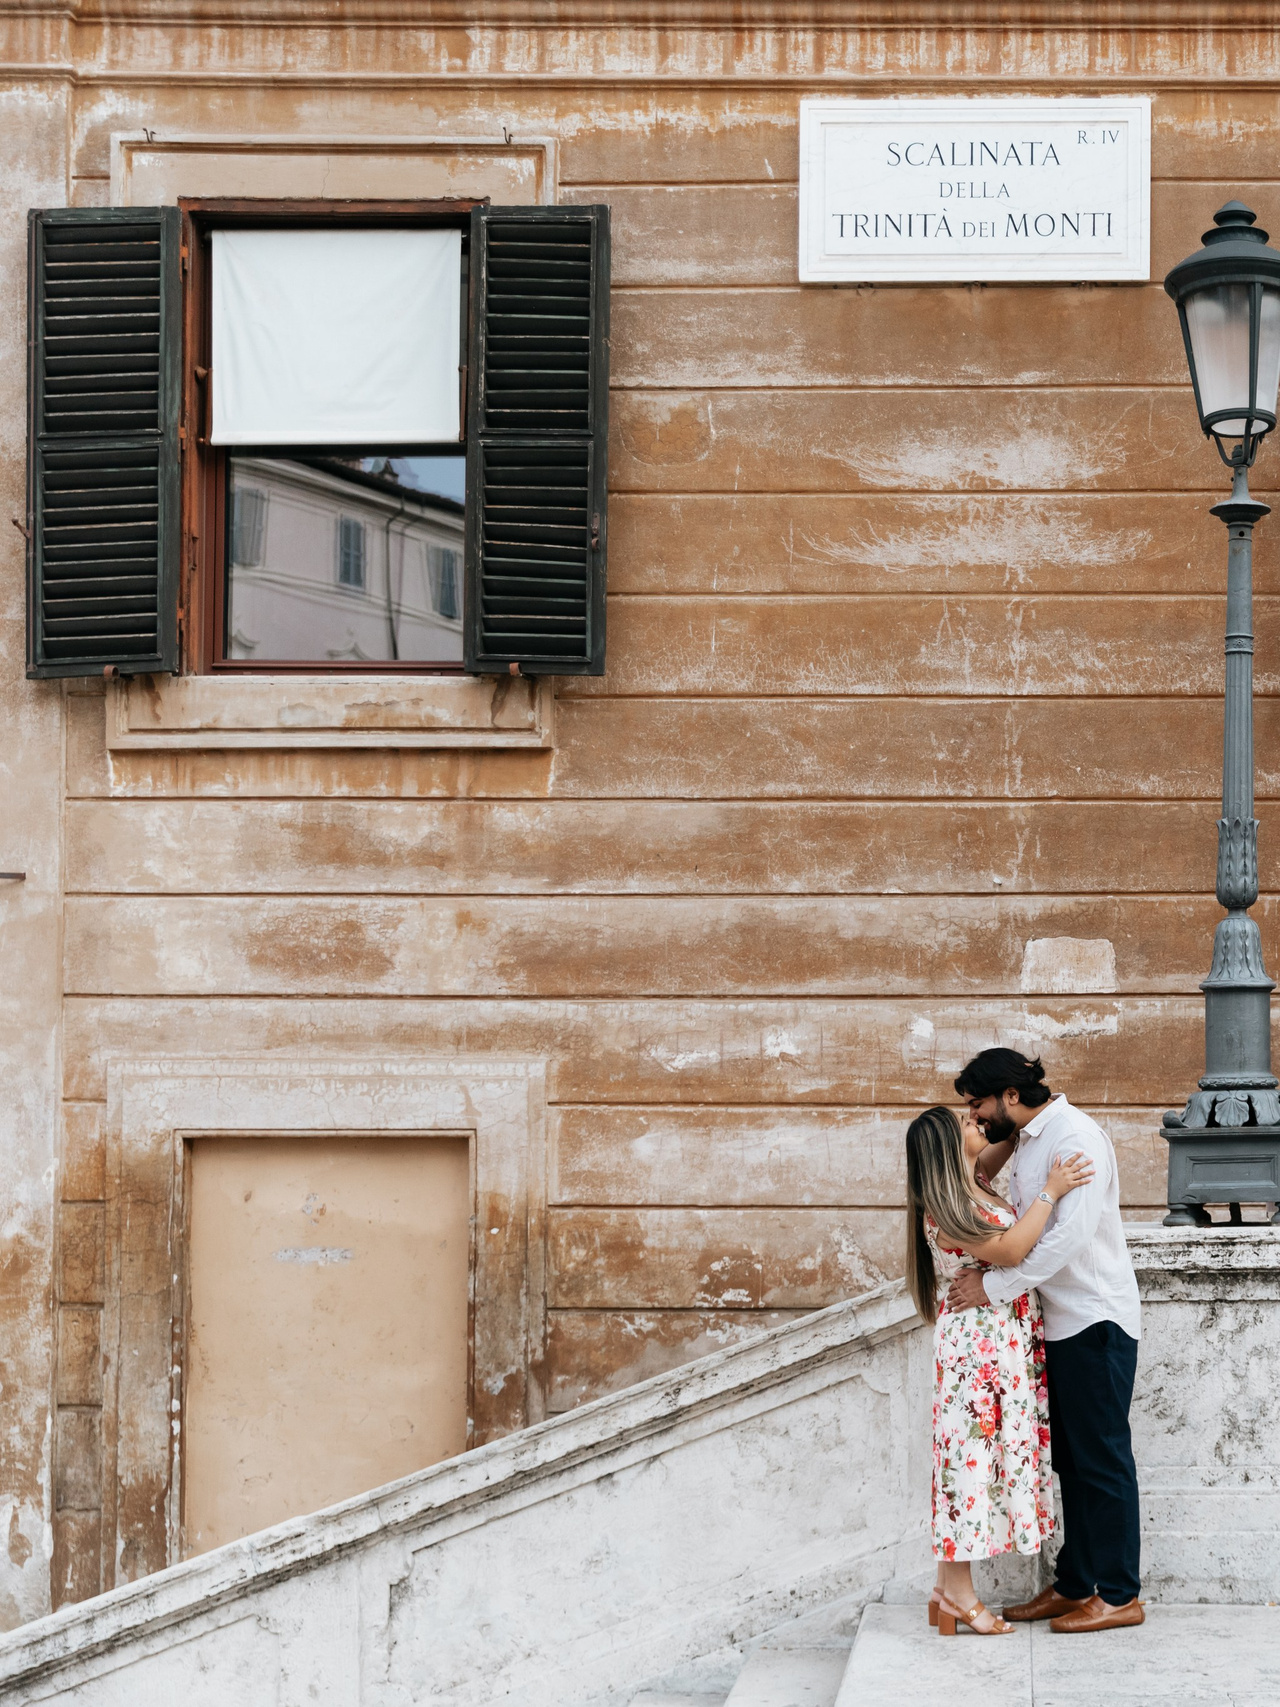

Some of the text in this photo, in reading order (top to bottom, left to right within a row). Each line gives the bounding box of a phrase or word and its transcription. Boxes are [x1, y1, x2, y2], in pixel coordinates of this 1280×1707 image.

[1102, 130, 1120, 145] IV
[887, 141, 1061, 167] SCALINATA
[939, 181, 1011, 199] DELLA
[831, 207, 1112, 238] TRINITÀ DEI MONTI
